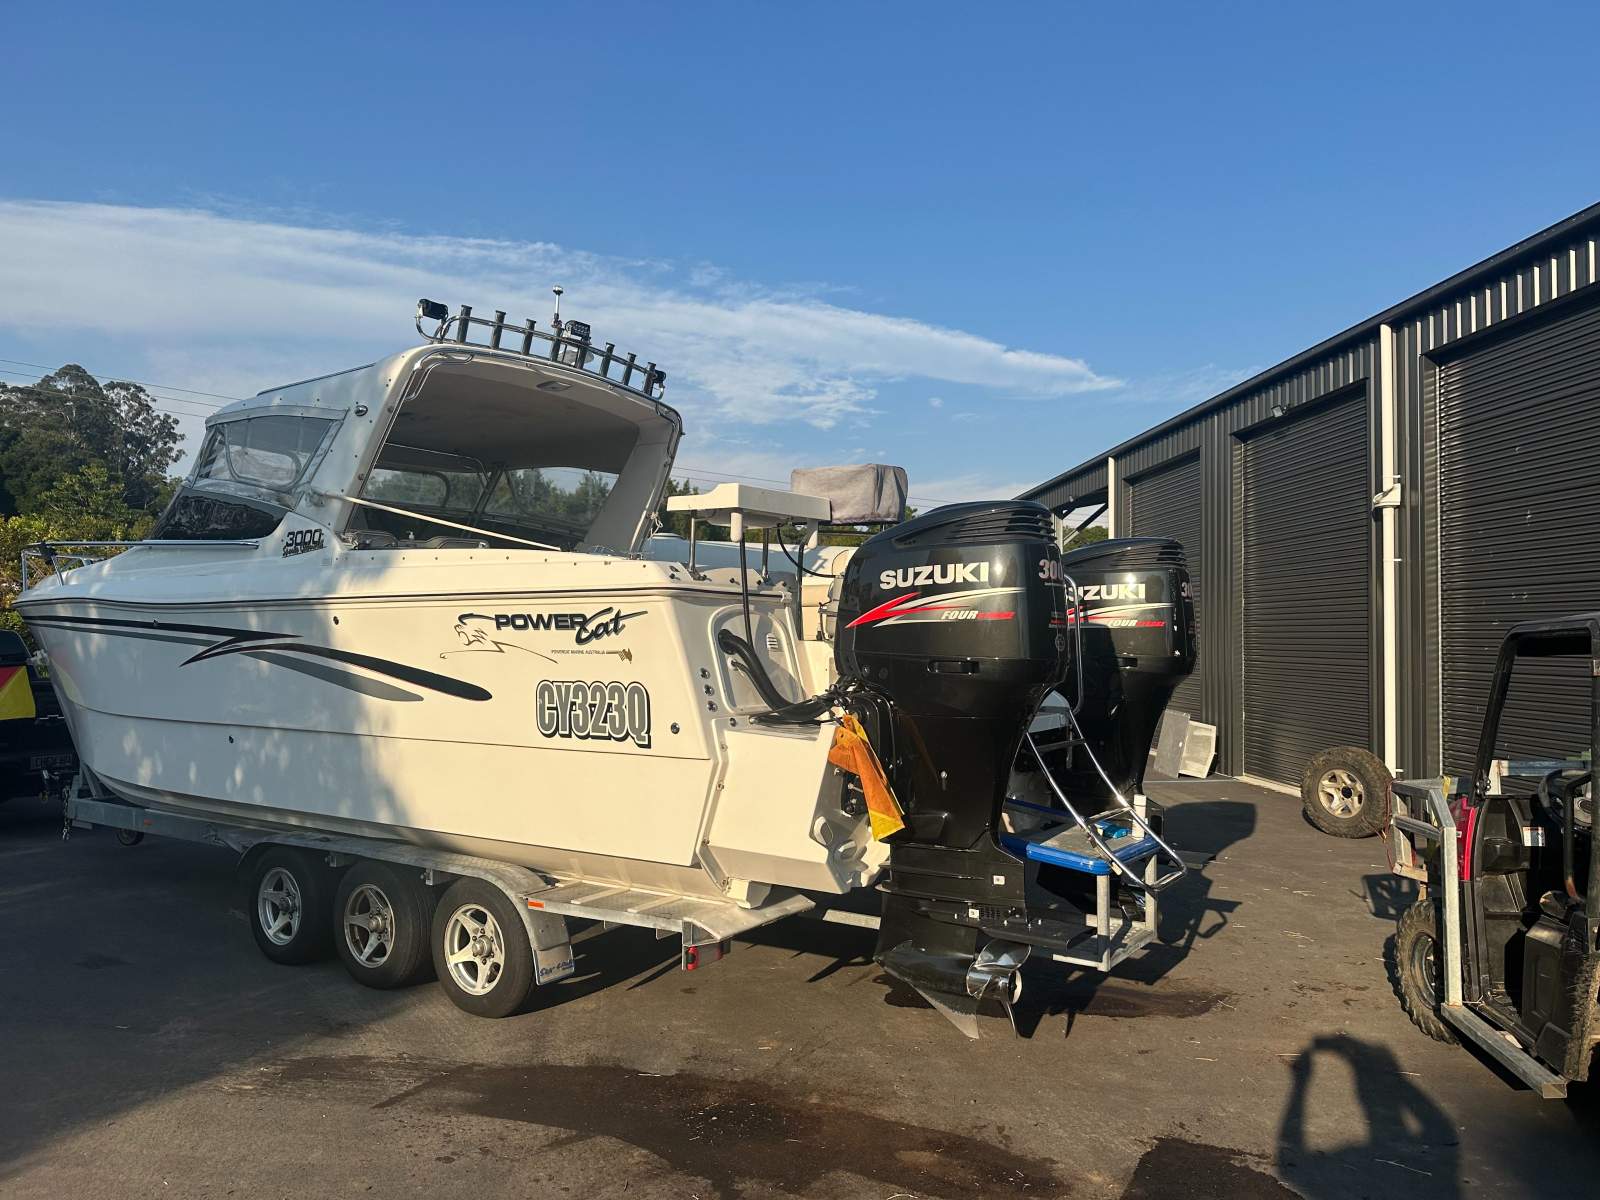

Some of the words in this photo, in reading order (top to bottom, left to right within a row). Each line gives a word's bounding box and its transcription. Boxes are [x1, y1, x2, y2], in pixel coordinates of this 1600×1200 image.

[285, 529, 322, 546] 3000
[880, 562, 989, 590] SUZUKI
[1067, 584, 1145, 602] UZUKI
[1181, 582, 1192, 597] 30
[940, 610, 979, 620] FOUR
[495, 613, 587, 630] POWER
[575, 606, 649, 645] Cat
[536, 679, 651, 748] CY323Q
